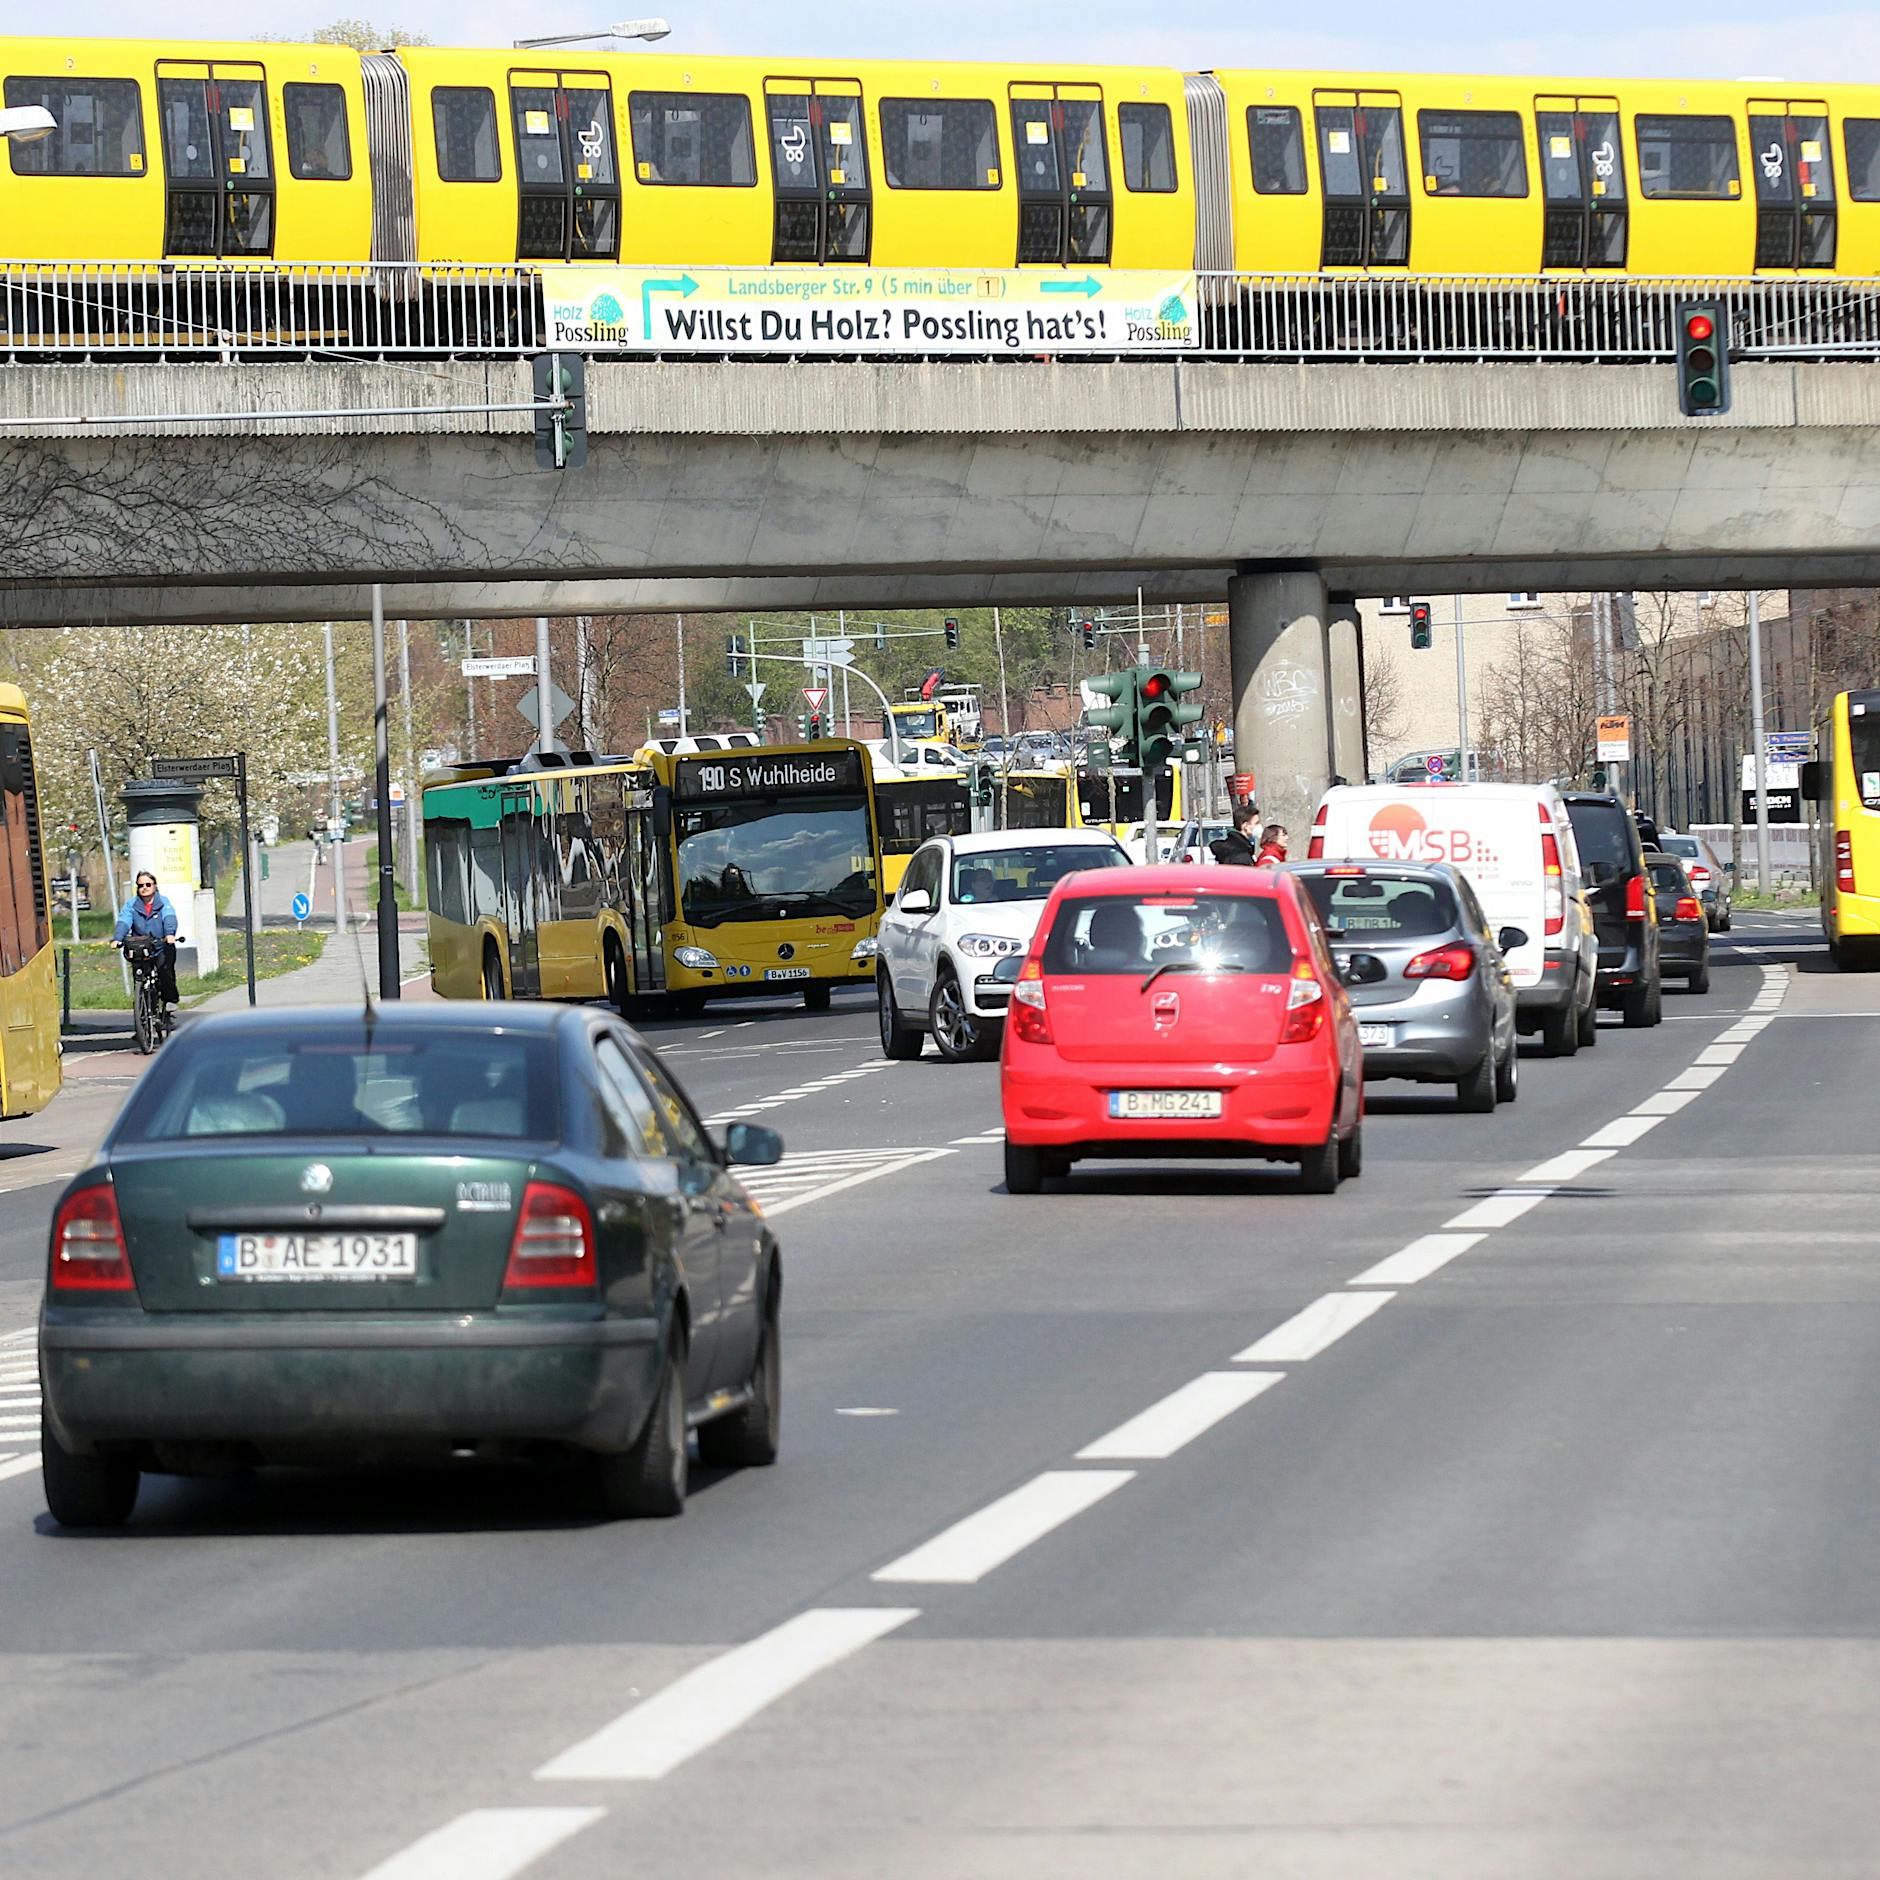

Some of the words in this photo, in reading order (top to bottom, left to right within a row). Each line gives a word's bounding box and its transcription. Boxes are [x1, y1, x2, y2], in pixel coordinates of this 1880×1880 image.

[728, 278, 827, 299] Landsberger
[833, 278, 860, 294] Str.
[864, 278, 873, 294] 9
[882, 277, 898, 296] (5
[904, 277, 932, 294] min
[938, 277, 972, 295] über
[553, 305, 582, 320] Holz
[1124, 307, 1152, 321] Holz
[555, 321, 628, 346] Possling
[665, 309, 752, 341] Willst
[762, 310, 801, 341] Du
[811, 309, 892, 341] Holz?
[903, 309, 1018, 347] Possling
[1027, 309, 1106, 340] hat's!
[1127, 322, 1193, 345] Possling
[466, 662, 512, 671] Elsterwerdaer
[157, 762, 210, 773] Elsterwerdaer
[698, 766, 726, 791] 190
[729, 767, 742, 787] S
[746, 762, 836, 787] Wuhlheide
[1389, 829, 1473, 863] MSB
[771, 970, 777, 979] B
[782, 970, 788, 978] V
[788, 969, 808, 978] 1156
[1127, 1093, 1138, 1111] B
[1151, 1093, 1175, 1111] MG
[1179, 1093, 1212, 1111] 241
[240, 1237, 258, 1268] B
[282, 1237, 323, 1267] AE
[332, 1237, 409, 1267] 1931
